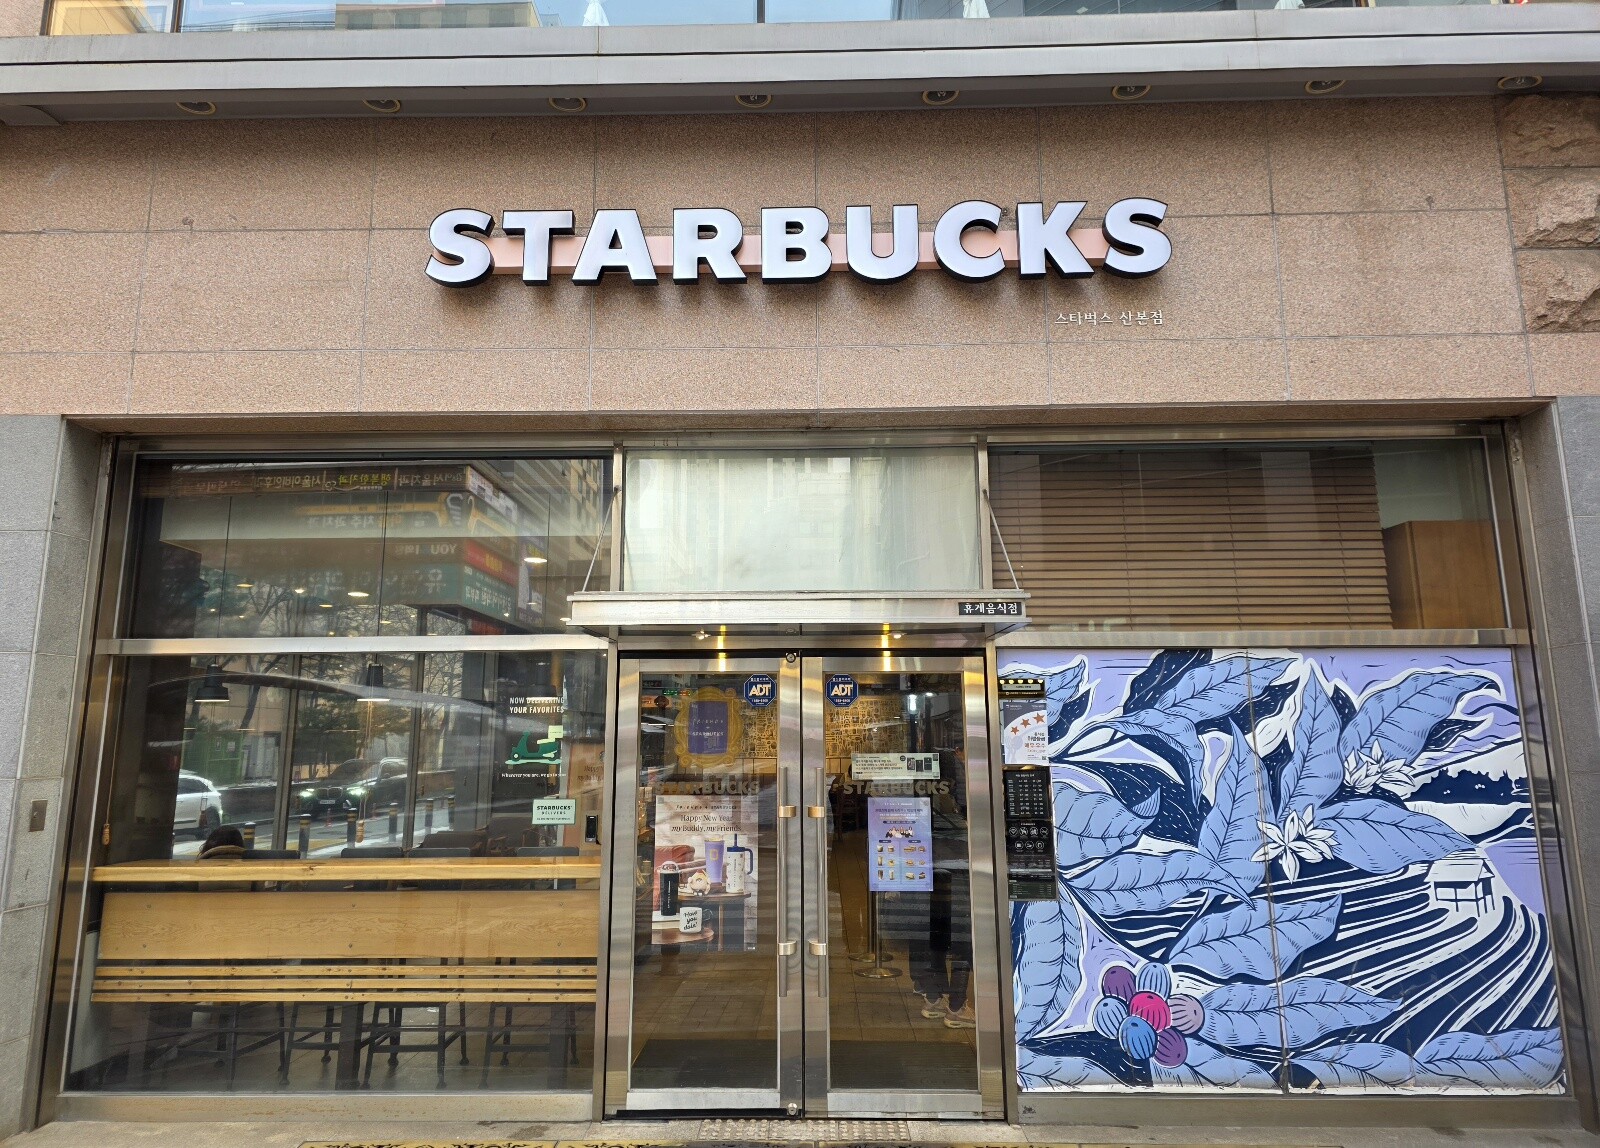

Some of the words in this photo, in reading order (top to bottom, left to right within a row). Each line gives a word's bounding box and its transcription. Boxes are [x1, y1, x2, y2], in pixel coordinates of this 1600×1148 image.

[427, 197, 1173, 286] STARBUCKS
[1054, 311, 1113, 325] 스타벅스
[1119, 309, 1163, 326] 산본점
[963, 602, 1018, 614] 휴게음식점
[749, 684, 771, 697] ADT
[831, 684, 853, 696] ADT
[509, 706, 527, 714] YOUR
[529, 705, 565, 714] FAVORITES
[656, 781, 760, 795] STARBUCKS
[843, 780, 950, 795] STARBUCKS
[680, 814, 702, 823] Happy
[703, 814, 717, 822] New
